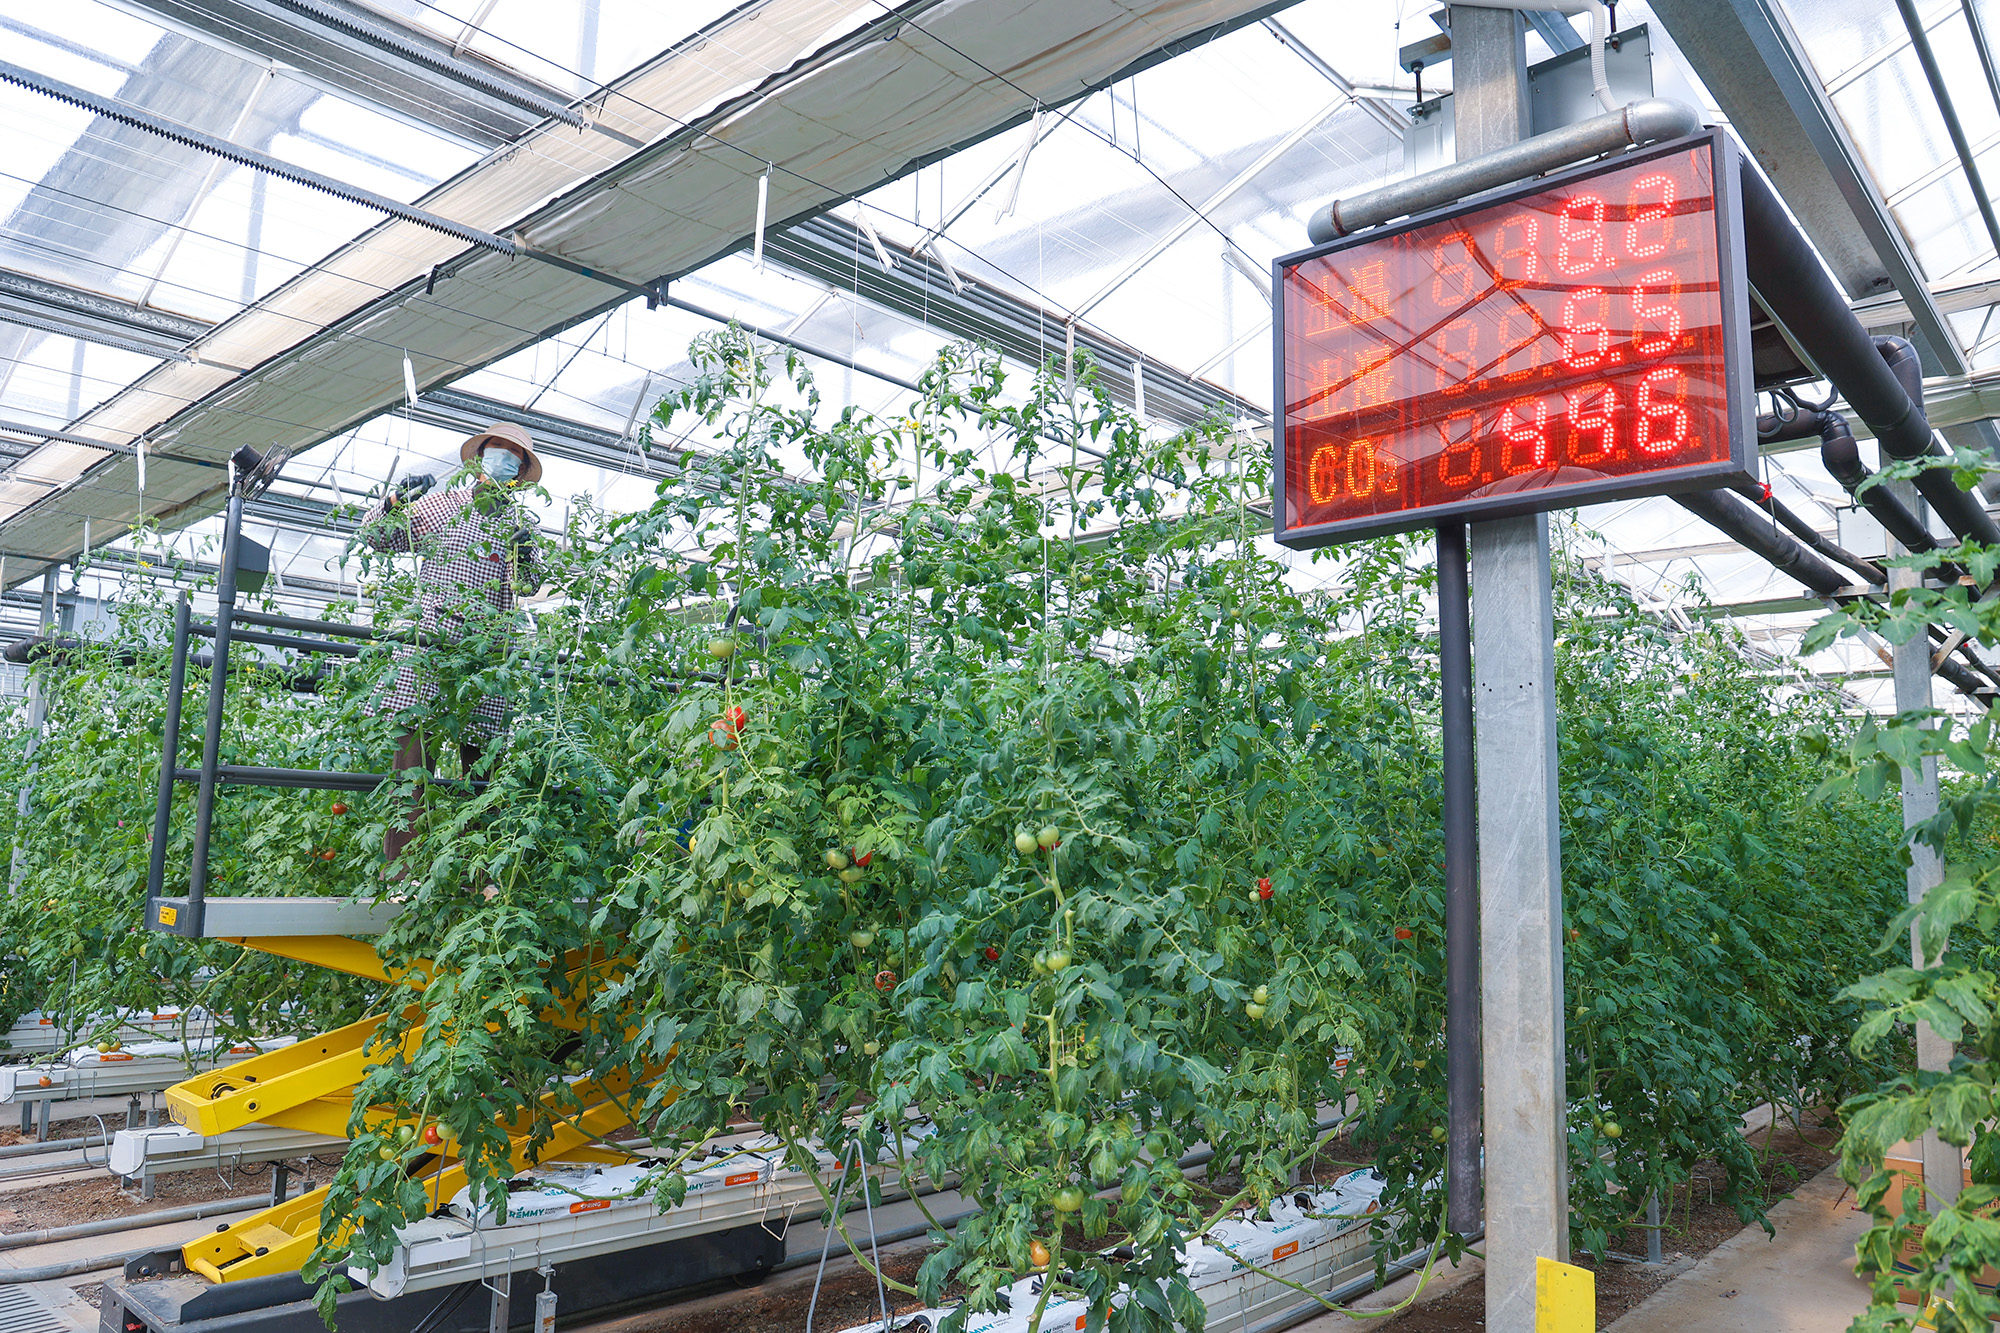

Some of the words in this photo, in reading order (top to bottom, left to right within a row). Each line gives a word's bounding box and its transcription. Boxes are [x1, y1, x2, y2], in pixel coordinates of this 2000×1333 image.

[1306, 260, 1395, 337] 土温
[1305, 344, 1396, 421] 土湿
[1563, 270, 1681, 368] 6.5
[1502, 367, 1688, 465] 446
[733, 1174, 751, 1183] SPRING
[580, 1201, 602, 1210] SPRING
[508, 1207, 545, 1219] REMMY
[1278, 1245, 1294, 1256] SPRING
